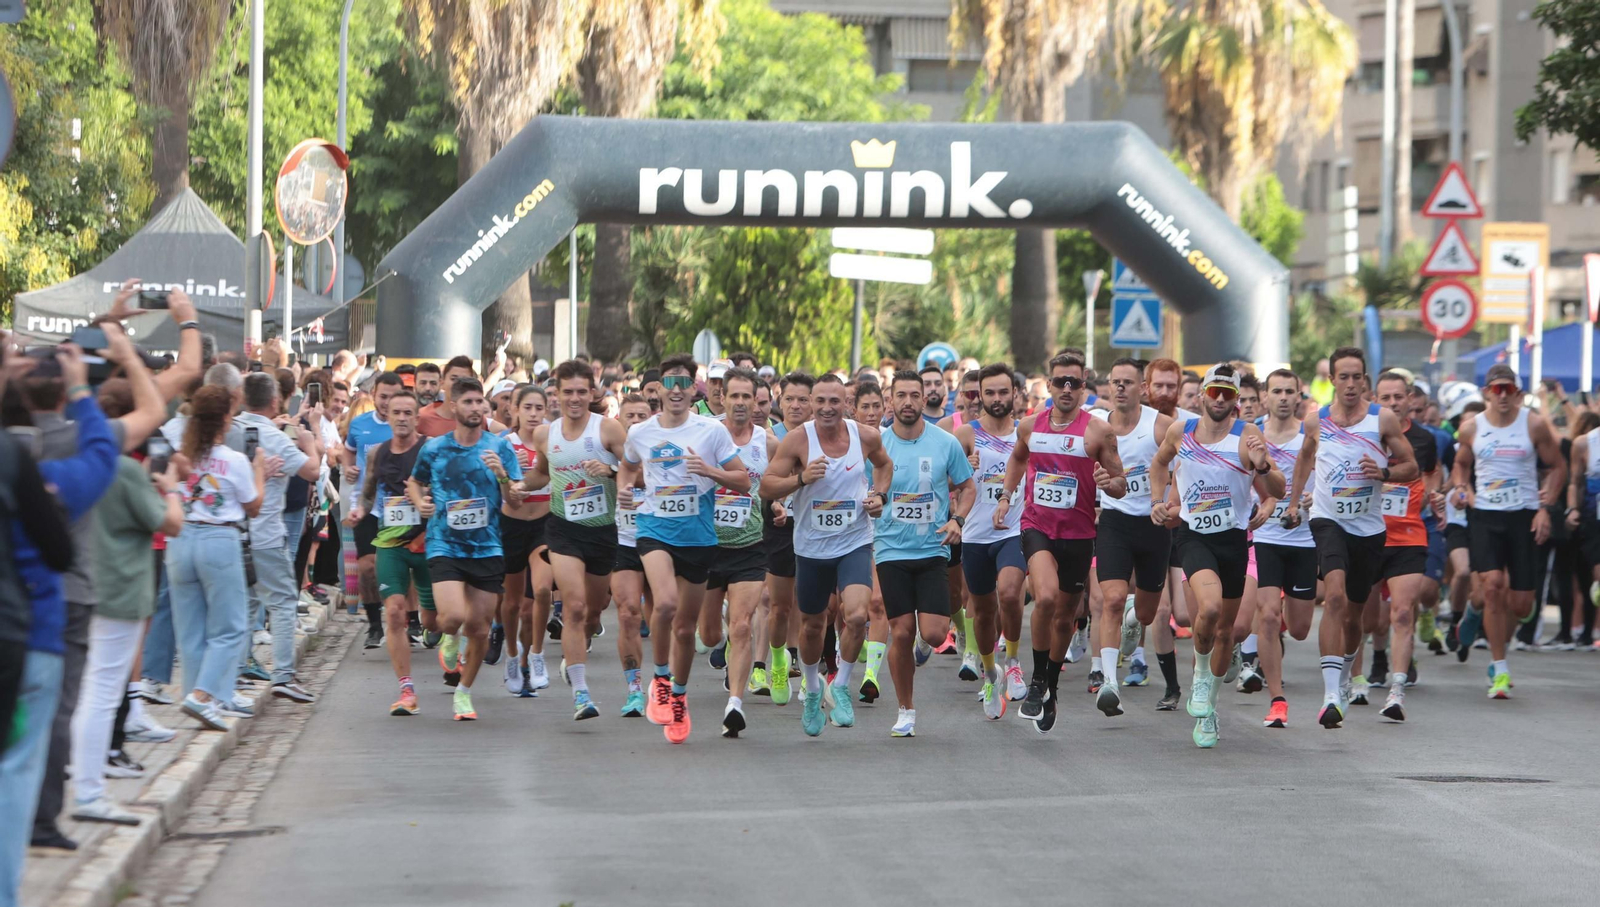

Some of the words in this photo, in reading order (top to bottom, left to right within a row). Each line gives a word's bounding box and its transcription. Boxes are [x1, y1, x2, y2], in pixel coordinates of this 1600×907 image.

[638, 141, 1033, 219] runnink.
[442, 178, 555, 284] runnink.com
[1116, 183, 1229, 290] runnink.com
[1434, 299, 1466, 318] 30
[1038, 487, 1062, 503] 233
[570, 501, 594, 516] 278
[659, 499, 685, 512] 426
[897, 506, 922, 519] 223
[1336, 501, 1362, 514] 312
[389, 510, 404, 521] 30
[452, 513, 477, 526] 262
[714, 509, 738, 523] 429
[817, 513, 843, 526] 188
[1194, 514, 1221, 530] 290
